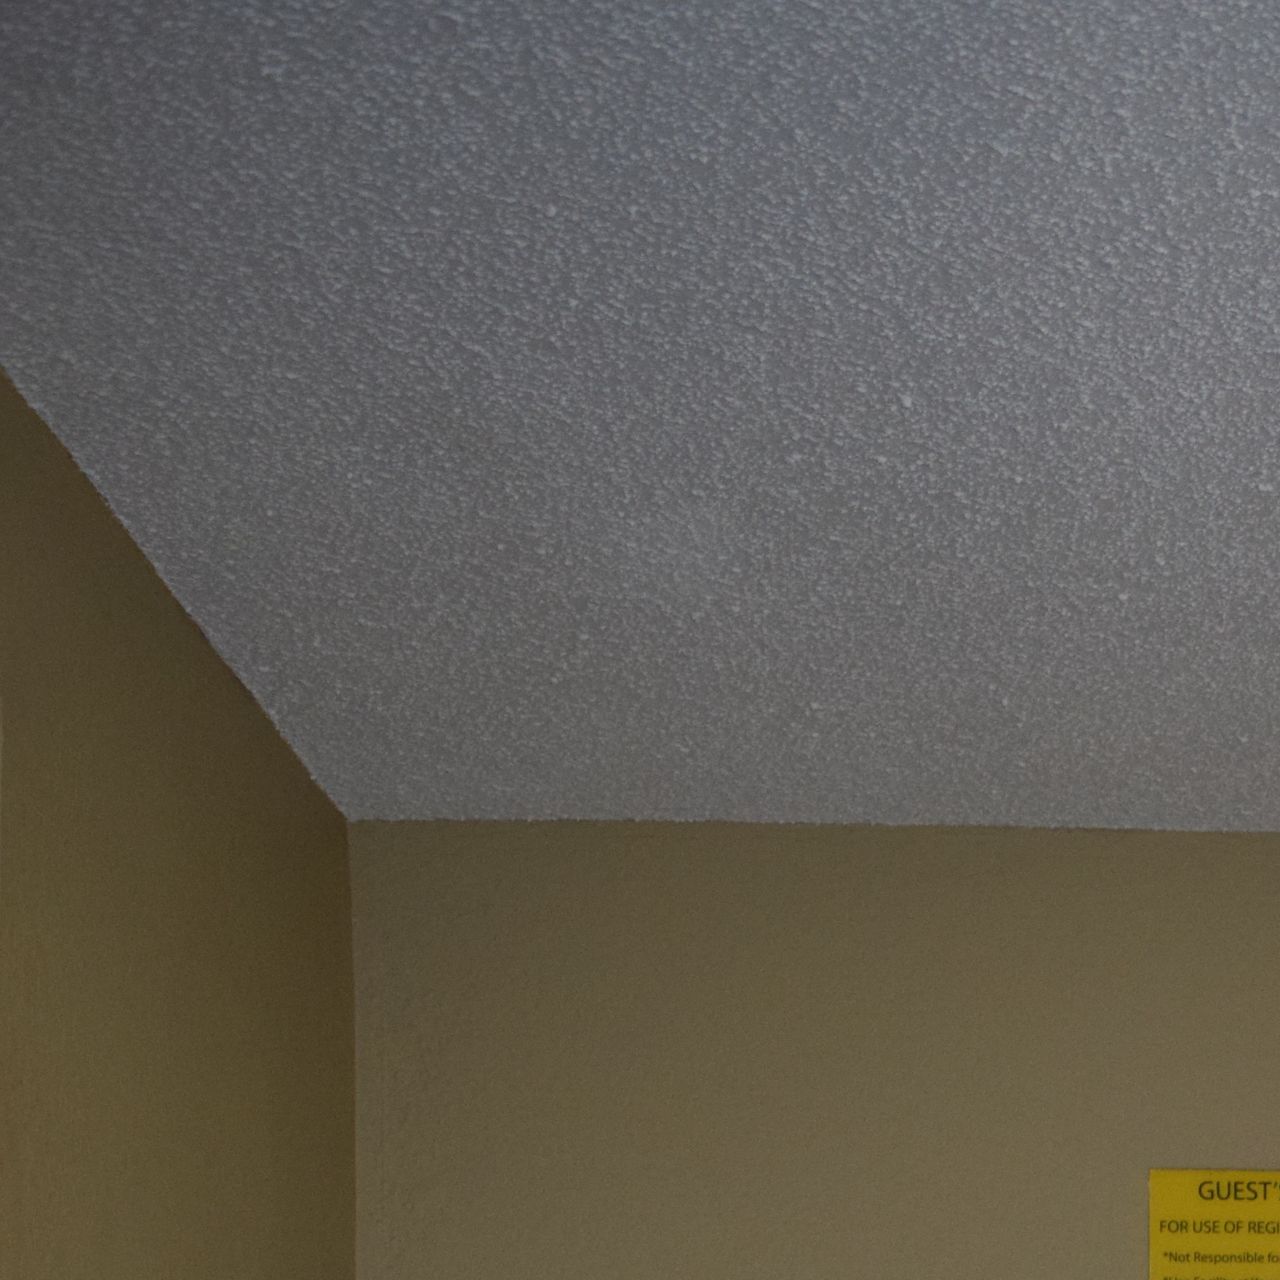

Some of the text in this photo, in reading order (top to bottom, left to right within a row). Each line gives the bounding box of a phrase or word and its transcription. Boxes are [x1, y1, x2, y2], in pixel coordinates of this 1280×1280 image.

[1160, 1219, 1188, 1233] FOR
[1193, 1220, 1220, 1234] USE
[1224, 1220, 1243, 1234] OF
[1193, 1251, 1265, 1264] Responsible
